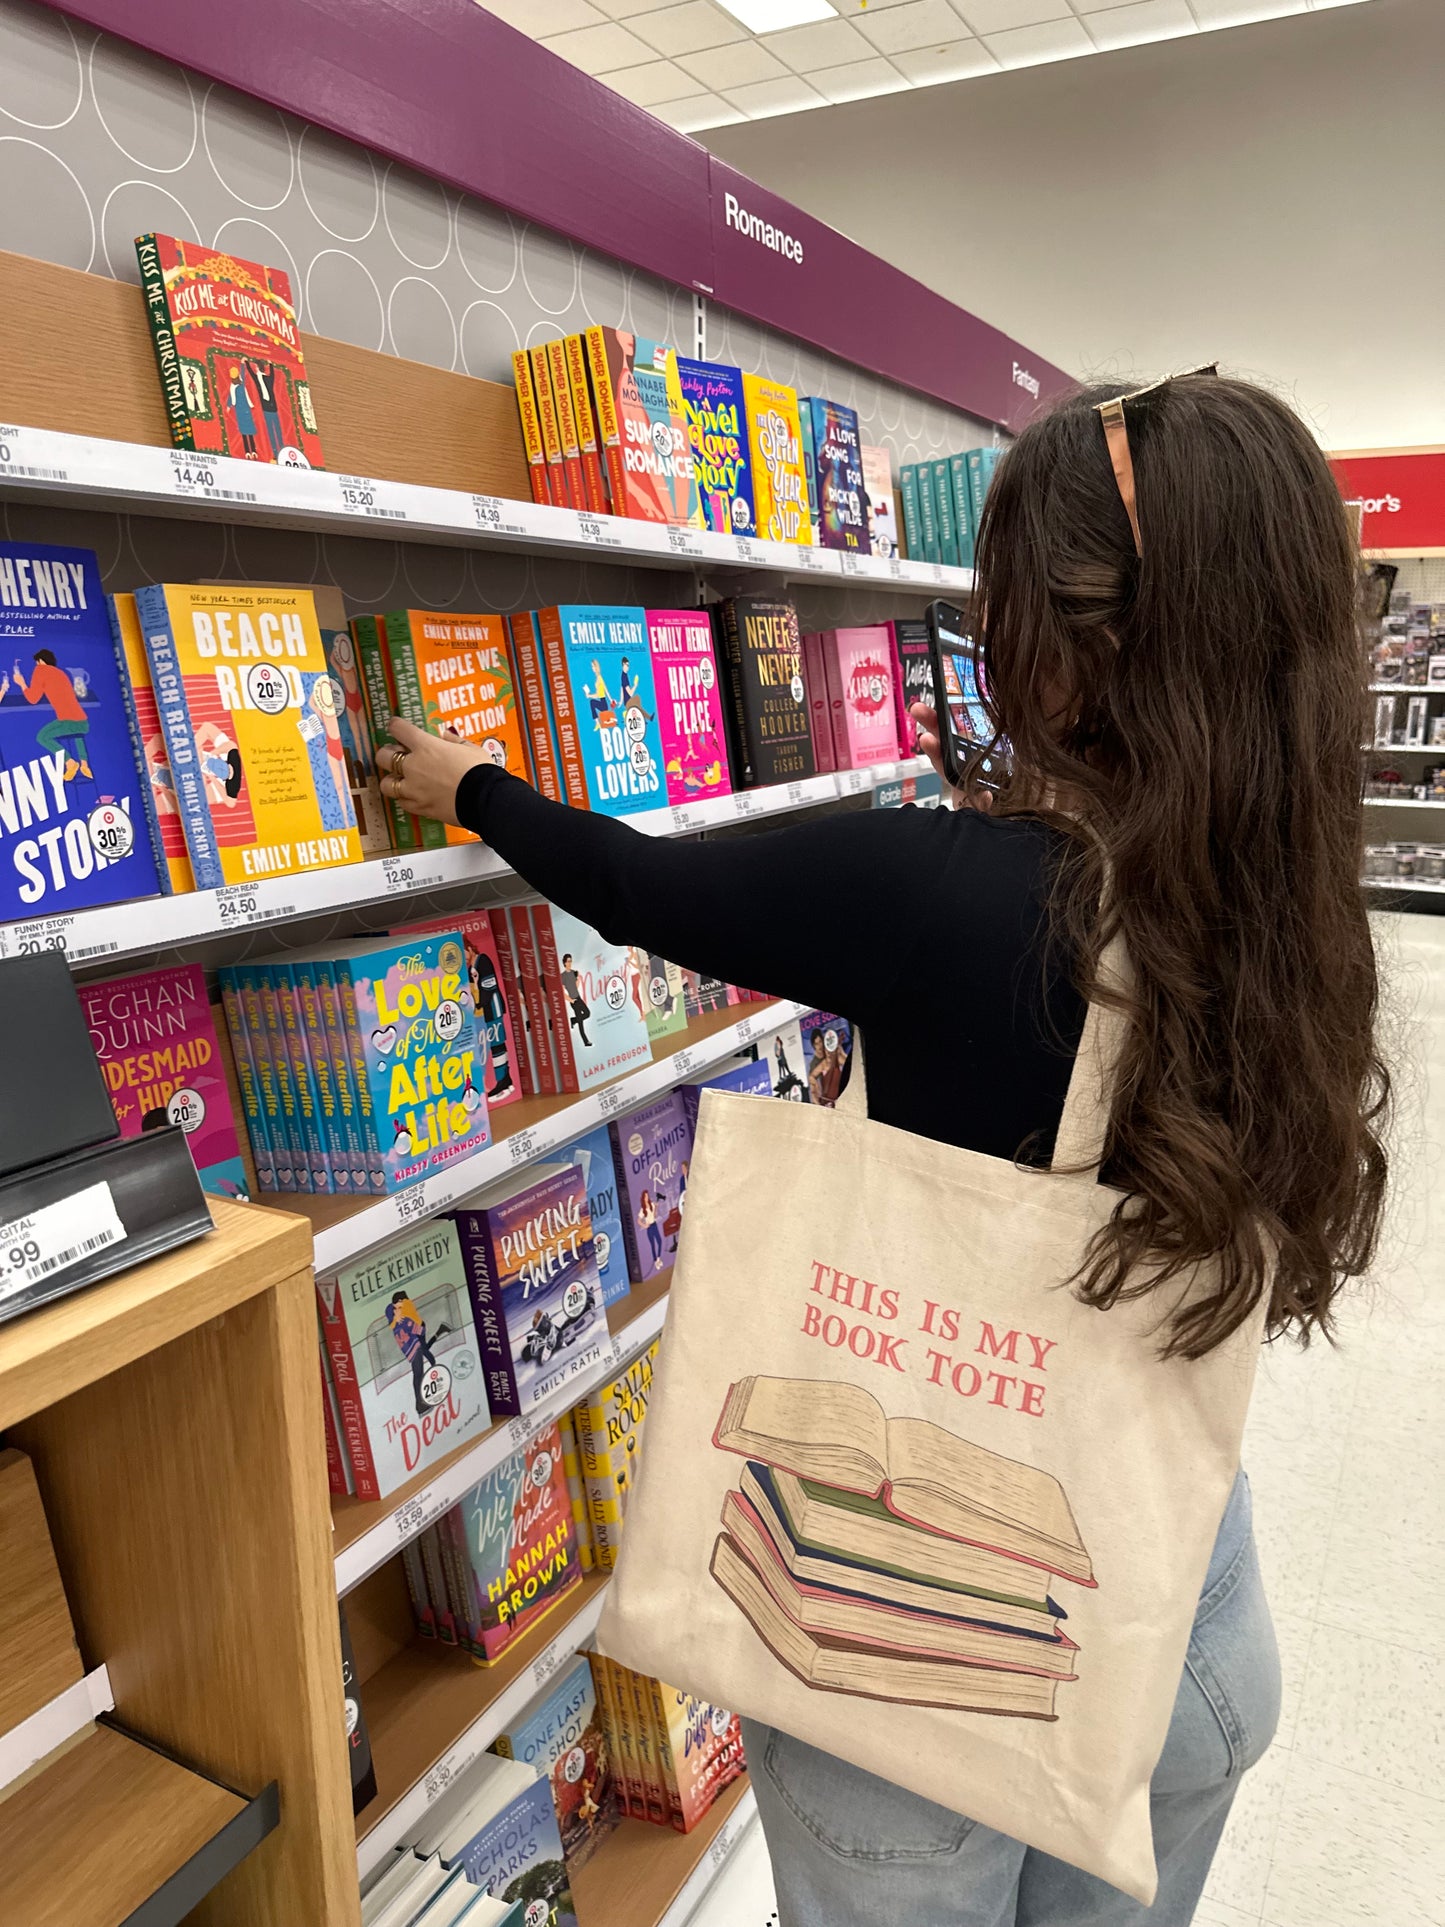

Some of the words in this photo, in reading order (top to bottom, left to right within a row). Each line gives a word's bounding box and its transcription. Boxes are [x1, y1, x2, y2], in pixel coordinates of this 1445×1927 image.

[725, 192, 803, 264] Romance
[139, 243, 157, 278] KISS
[146, 282, 163, 307] ME
[173, 285, 198, 316] KISS
[198, 283, 218, 310] ME
[217, 293, 229, 308] at
[229, 293, 296, 345] CHRISTMAS
[154, 309, 166, 324] at
[156, 330, 185, 420] CHRISTMAS
[568, 339, 582, 384] SUMMER
[576, 388, 591, 439] ROMANCE
[626, 375, 668, 396] ANNABEL
[1011, 361, 1040, 400] Fantasy
[515, 354, 529, 397] SUMMER
[523, 402, 538, 451] ROMANCE
[534, 352, 549, 397] SUMMER
[542, 400, 557, 451] ROMANCE
[552, 345, 566, 391] SUMMER
[559, 394, 574, 445] ROMANCE
[622, 389, 679, 411] MONAGHAN
[682, 398, 740, 437] Novel
[829, 428, 837, 441] A
[837, 426, 857, 447] LOVE
[624, 447, 694, 479] ROMANCE
[688, 424, 740, 466] Love
[825, 445, 849, 464] SONG
[174, 467, 214, 486] 14.40
[846, 469, 862, 486] FOR
[342, 489, 373, 506] 15.20
[475, 507, 500, 522] 14.39
[906, 501, 914, 519] LAST
[580, 523, 600, 537] 14.39
[909, 521, 917, 545] LETTER
[0, 557, 87, 610] HENRY
[190, 593, 207, 602] NEW
[5, 625, 34, 634] PLACE
[191, 611, 308, 658] BEACH
[423, 624, 451, 640] EMILY
[455, 626, 489, 641] HENRY
[569, 622, 605, 644] EMILY
[609, 623, 643, 644] HENRY
[649, 626, 682, 653] EMILY
[685, 627, 712, 652] HENRY
[745, 616, 790, 649] NEVER
[150, 634, 178, 704] BEACH
[371, 650, 385, 689] PEOPLE
[424, 653, 476, 686] PEOPLE
[475, 647, 500, 671] WE
[520, 645, 532, 678] BOOK
[547, 642, 560, 674] BOOK
[757, 653, 801, 686] NEVER
[368, 678, 384, 729] VACATION
[437, 683, 477, 714] MEET
[480, 682, 496, 701] ON
[525, 680, 543, 721] LOVERS
[553, 675, 571, 718] LOVERS
[166, 709, 190, 764] READ
[674, 698, 713, 736] PLACE
[760, 712, 807, 737] HOOVER
[773, 756, 805, 774] FISHER
[180, 771, 202, 815] EMILY
[190, 817, 211, 859] HENRY
[242, 847, 292, 875] EMILY
[296, 835, 349, 866] HENRY
[382, 858, 401, 867] BEACH
[386, 868, 414, 884] 12.80
[215, 886, 240, 897] BEACH
[240, 882, 260, 892] READ
[219, 897, 257, 918] 24.50
[14, 922, 44, 935] FUNNY
[46, 916, 75, 928] STORY
[28, 931, 45, 939] EMILY
[46, 927, 65, 936] HENRY
[397, 952, 426, 982] The
[372, 972, 462, 1027] Love
[530, 992, 540, 1017] LANA
[801, 1014, 821, 1031] LOVE
[534, 1018, 548, 1067] FERGUSON
[582, 1063, 606, 1079] LANA
[606, 1045, 648, 1066] FERGUSON
[240, 1061, 259, 1117] Afterlife
[258, 1060, 277, 1117] Afterlife
[315, 1058, 335, 1117] Afterlife
[387, 1051, 474, 1115] After
[404, 1102, 471, 1157] Life
[510, 1140, 532, 1158] 15.20
[631, 1123, 686, 1175] OFF-LIMITS
[394, 1158, 430, 1182] KIRSTY
[430, 1132, 488, 1164] GREENWOOD
[648, 1149, 678, 1193] Rule
[395, 1192, 406, 1201] THE
[406, 1187, 418, 1196] LOVE
[419, 1182, 426, 1190] OF
[398, 1195, 425, 1217] 15.20
[19, 1231, 31, 1241] US
[501, 1195, 582, 1268] PUCKING
[351, 1268, 384, 1302] ELLE
[388, 1236, 451, 1283] KENNEDY
[472, 1244, 494, 1304] PUCKING
[519, 1229, 580, 1299] SWEET
[480, 1308, 501, 1355] SWEET
[810, 1259, 900, 1320] THIS
[918, 1299, 961, 1341] IS
[974, 1320, 1058, 1371] MY
[533, 1367, 567, 1401] EMILY
[570, 1347, 601, 1374] RATH
[800, 1302, 909, 1373] BOOK
[926, 1347, 1047, 1418] TOTE
[489, 1370, 501, 1401] RATH
[333, 1353, 354, 1384] Deal
[348, 1426, 367, 1472] KENNEDY
[383, 1410, 408, 1443] The
[509, 1418, 533, 1441] 15.96
[400, 1395, 462, 1472] Deal
[397, 1508, 423, 1533] 13.59
[472, 1496, 508, 1553] We
[591, 1488, 606, 1524] SALLY
[493, 1486, 553, 1568] Made
[596, 1524, 613, 1569] ROONEY
[487, 1519, 568, 1603] HANNAH
[497, 1548, 568, 1624] BROWN
[523, 1724, 555, 1762] ONE
[557, 1688, 587, 1725] LAST
[549, 1716, 583, 1763] SHOT
